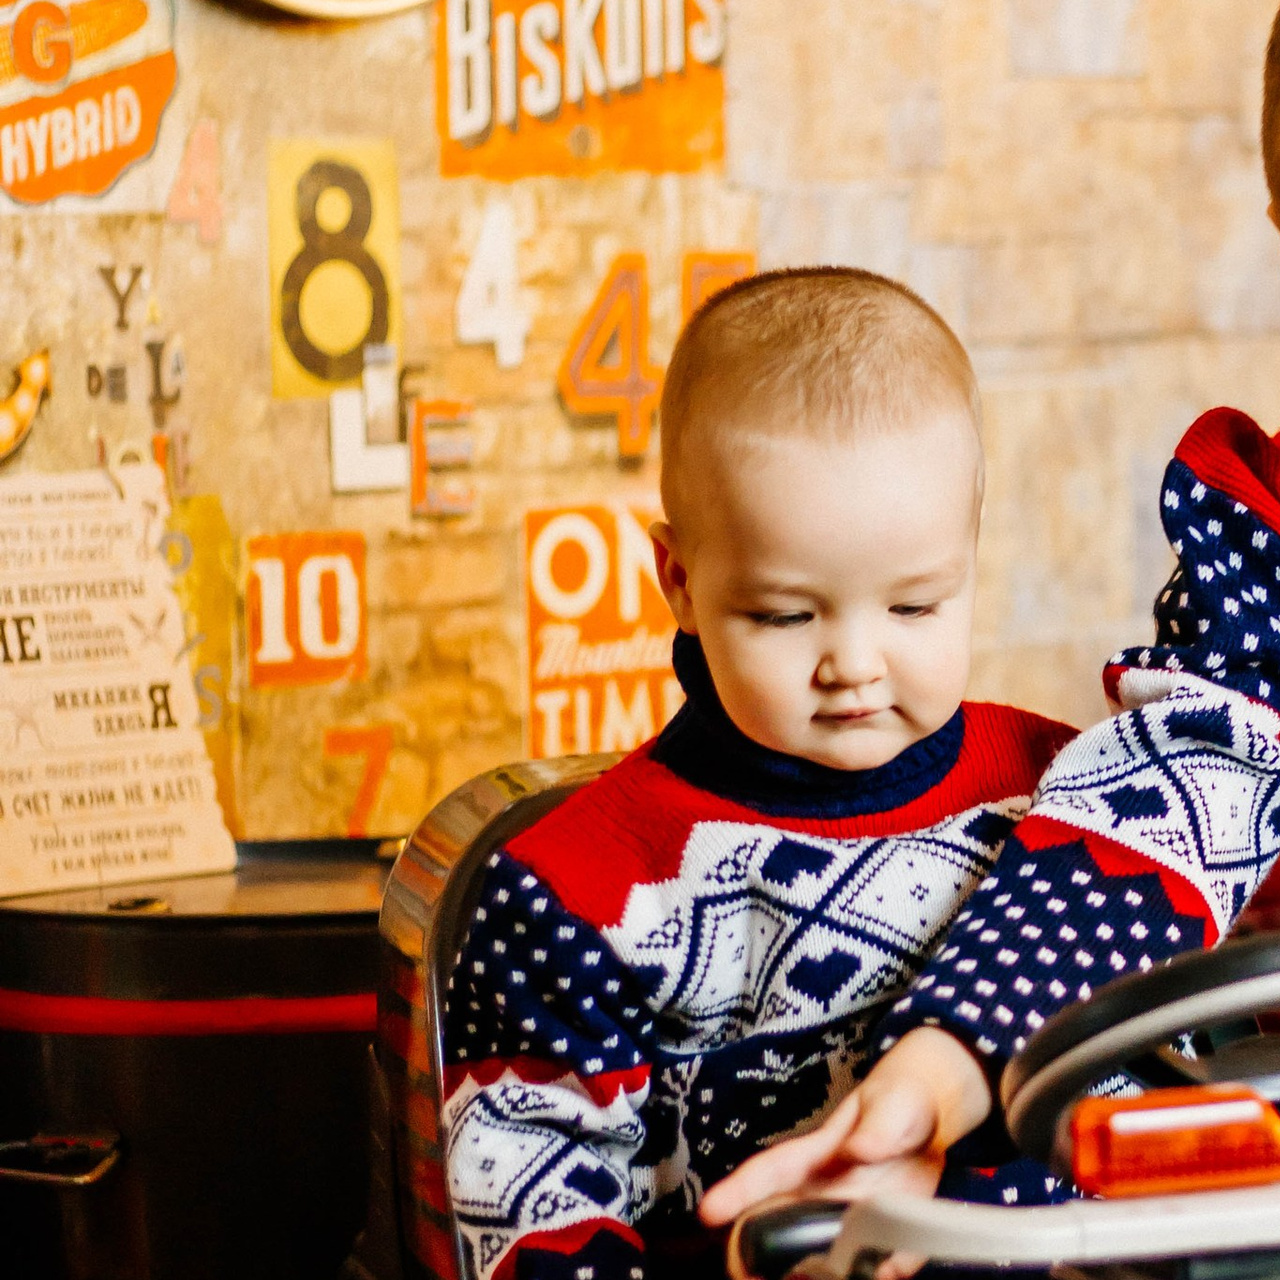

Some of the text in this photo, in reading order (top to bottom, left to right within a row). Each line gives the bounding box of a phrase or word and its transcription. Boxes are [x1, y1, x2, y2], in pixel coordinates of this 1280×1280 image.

[2, 84, 142, 188] HYBRID
[281, 159, 389, 381] 8
[457, 198, 532, 368] 4
[252, 553, 361, 666] 10
[149, 682, 178, 730] Я
